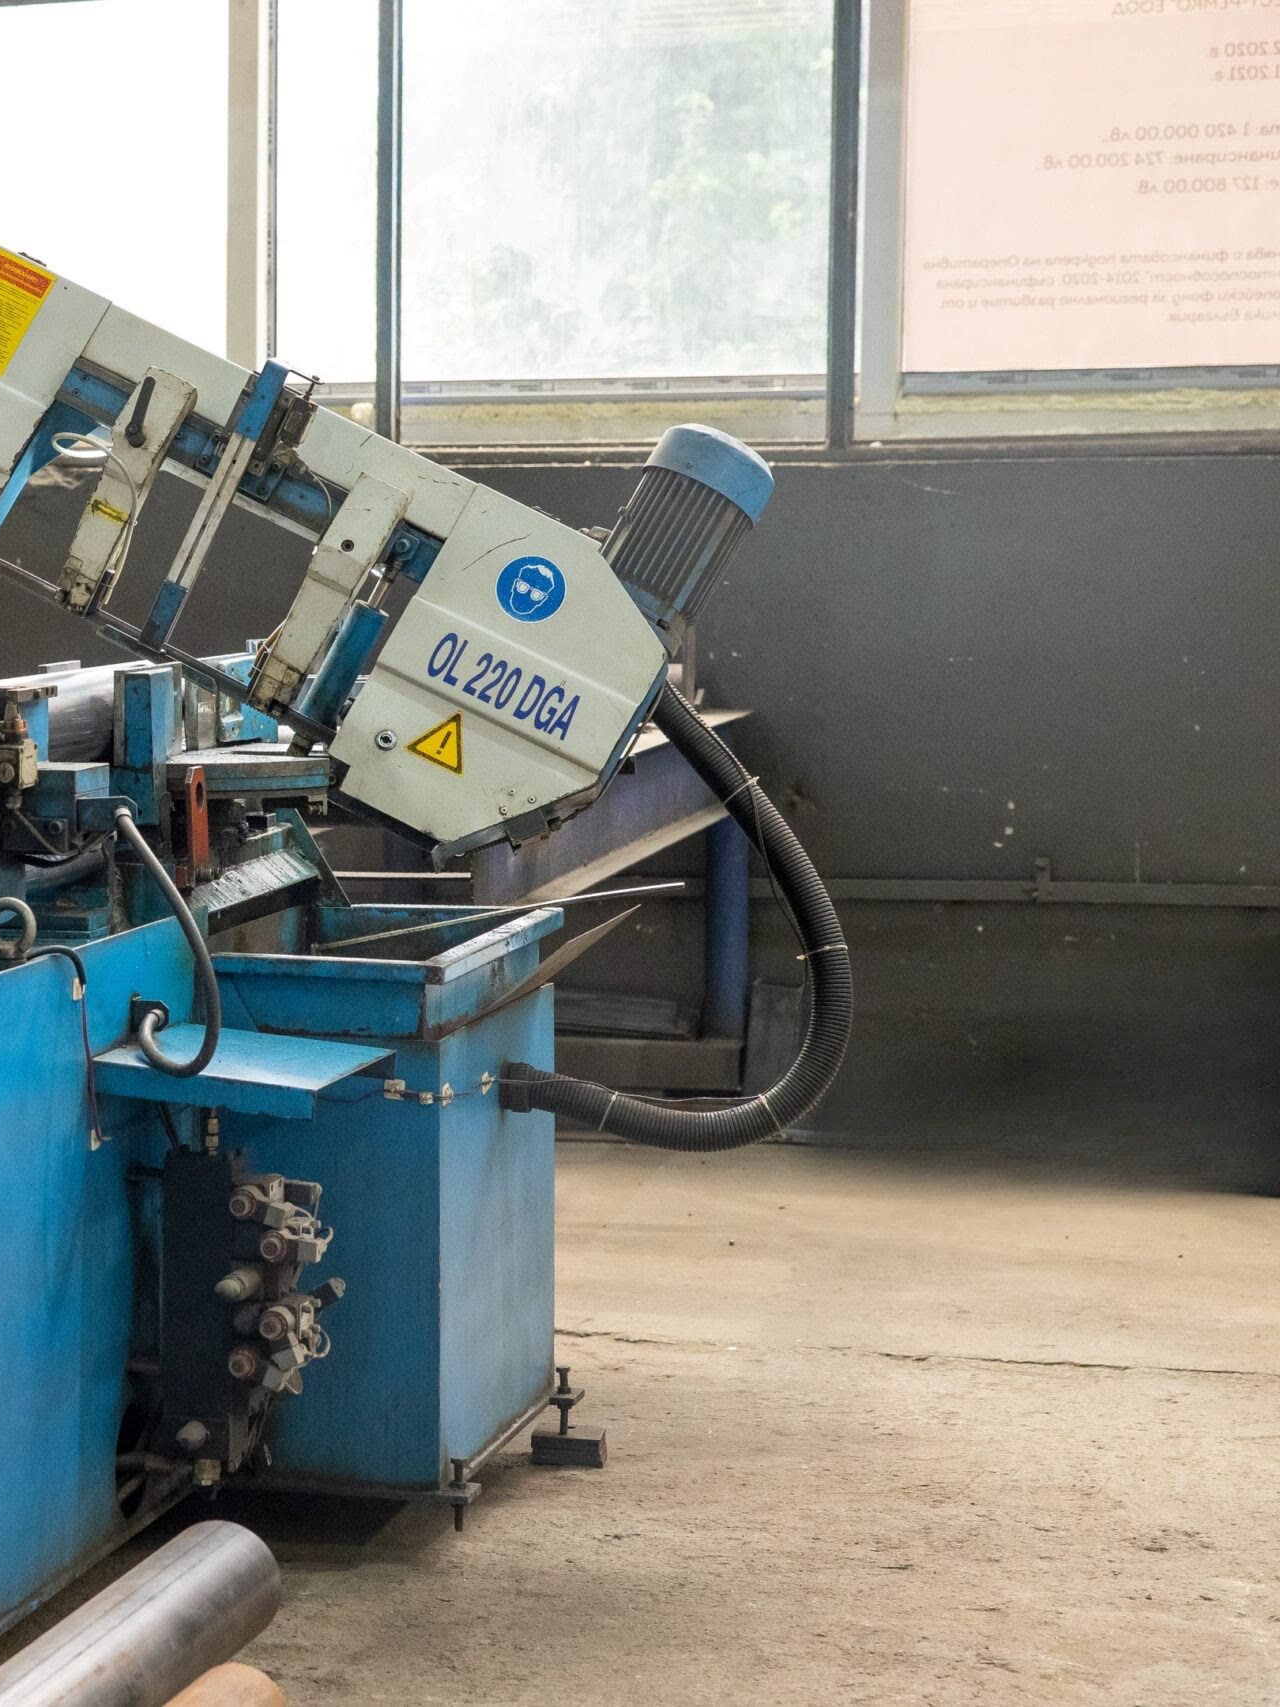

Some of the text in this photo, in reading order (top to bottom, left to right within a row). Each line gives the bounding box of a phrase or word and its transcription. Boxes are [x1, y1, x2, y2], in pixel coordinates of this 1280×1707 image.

[427, 632, 581, 741] OL 220 DGA
